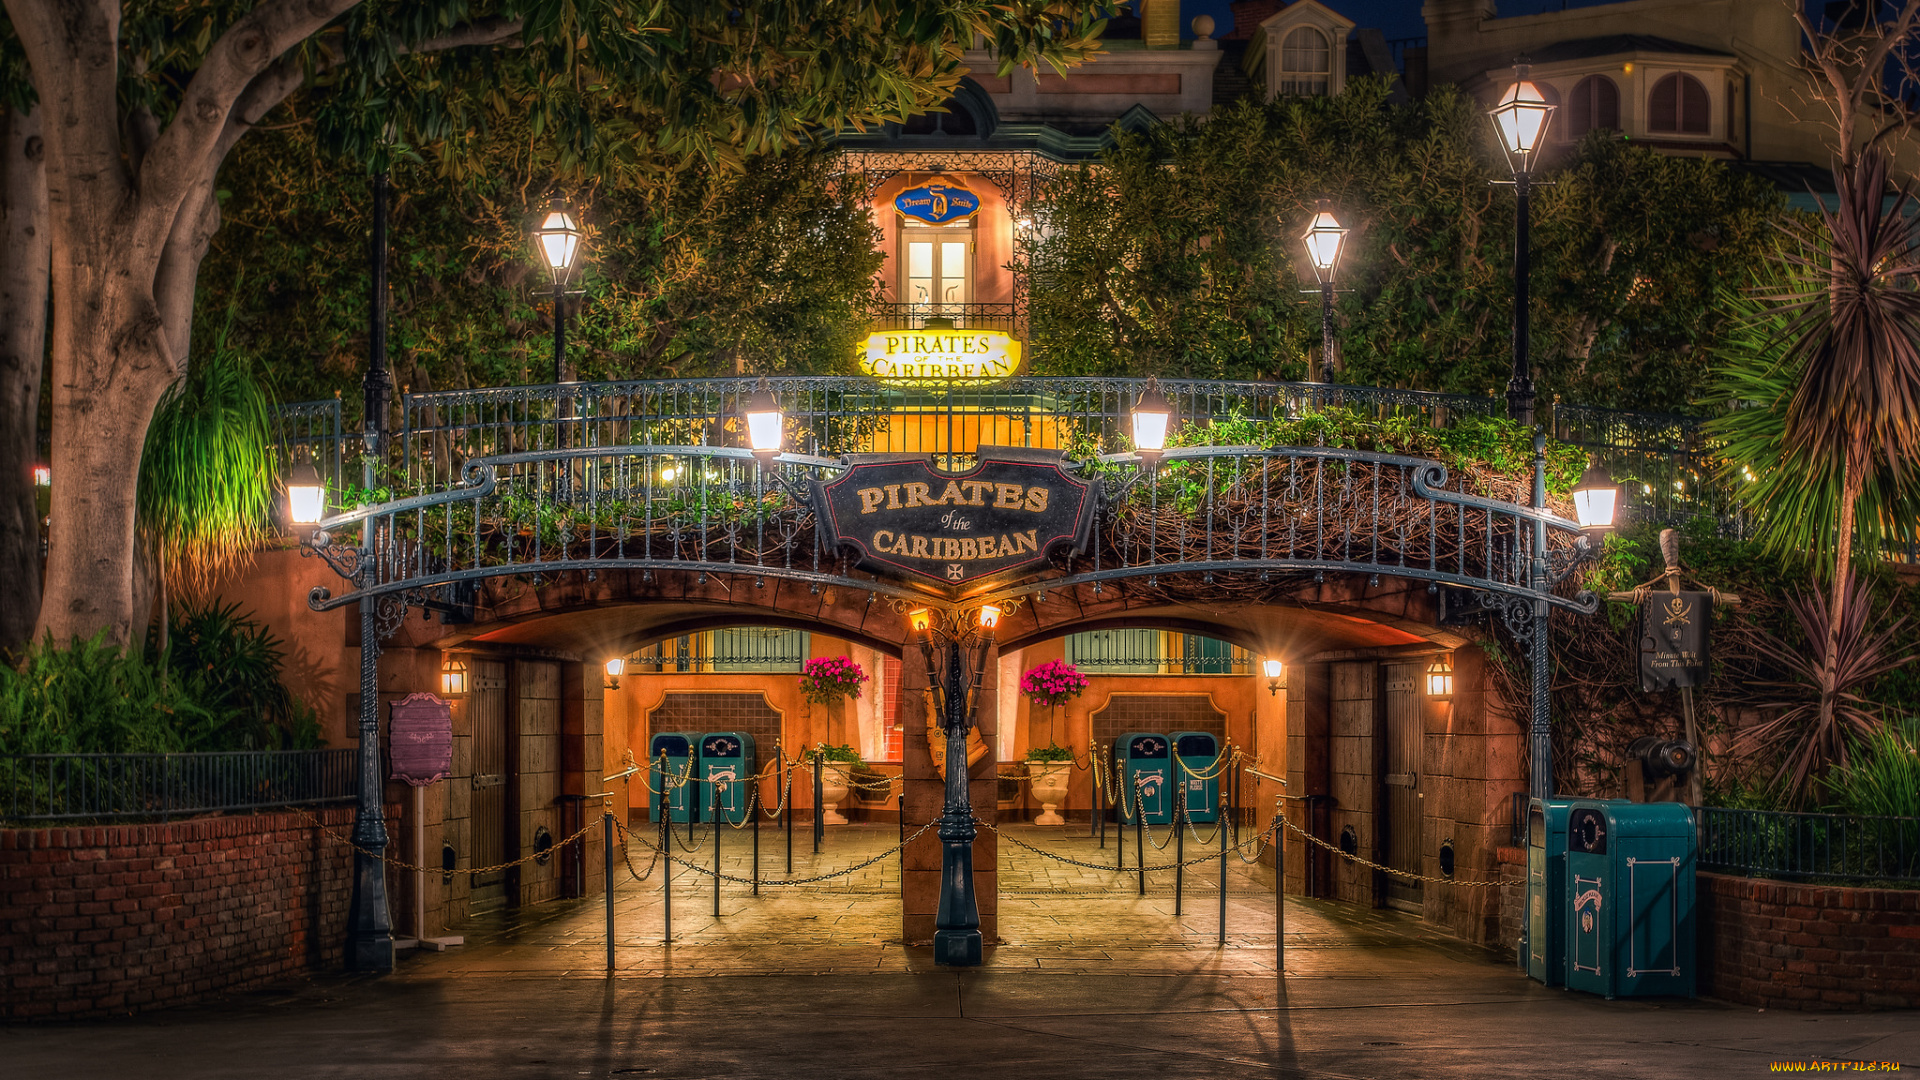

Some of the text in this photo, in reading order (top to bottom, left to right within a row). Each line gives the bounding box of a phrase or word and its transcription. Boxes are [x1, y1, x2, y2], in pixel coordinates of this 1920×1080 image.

[885, 336, 990, 355] PIRATES
[870, 355, 1010, 377] CARIBBEAN
[857, 480, 1049, 514] PIRATES
[941, 510, 971, 531] of the
[873, 530, 1039, 561] CARIBBEAN
[1673, 631, 1679, 639] 5
[1651, 660, 1669, 668] From
[1655, 651, 1679, 659] Minute
